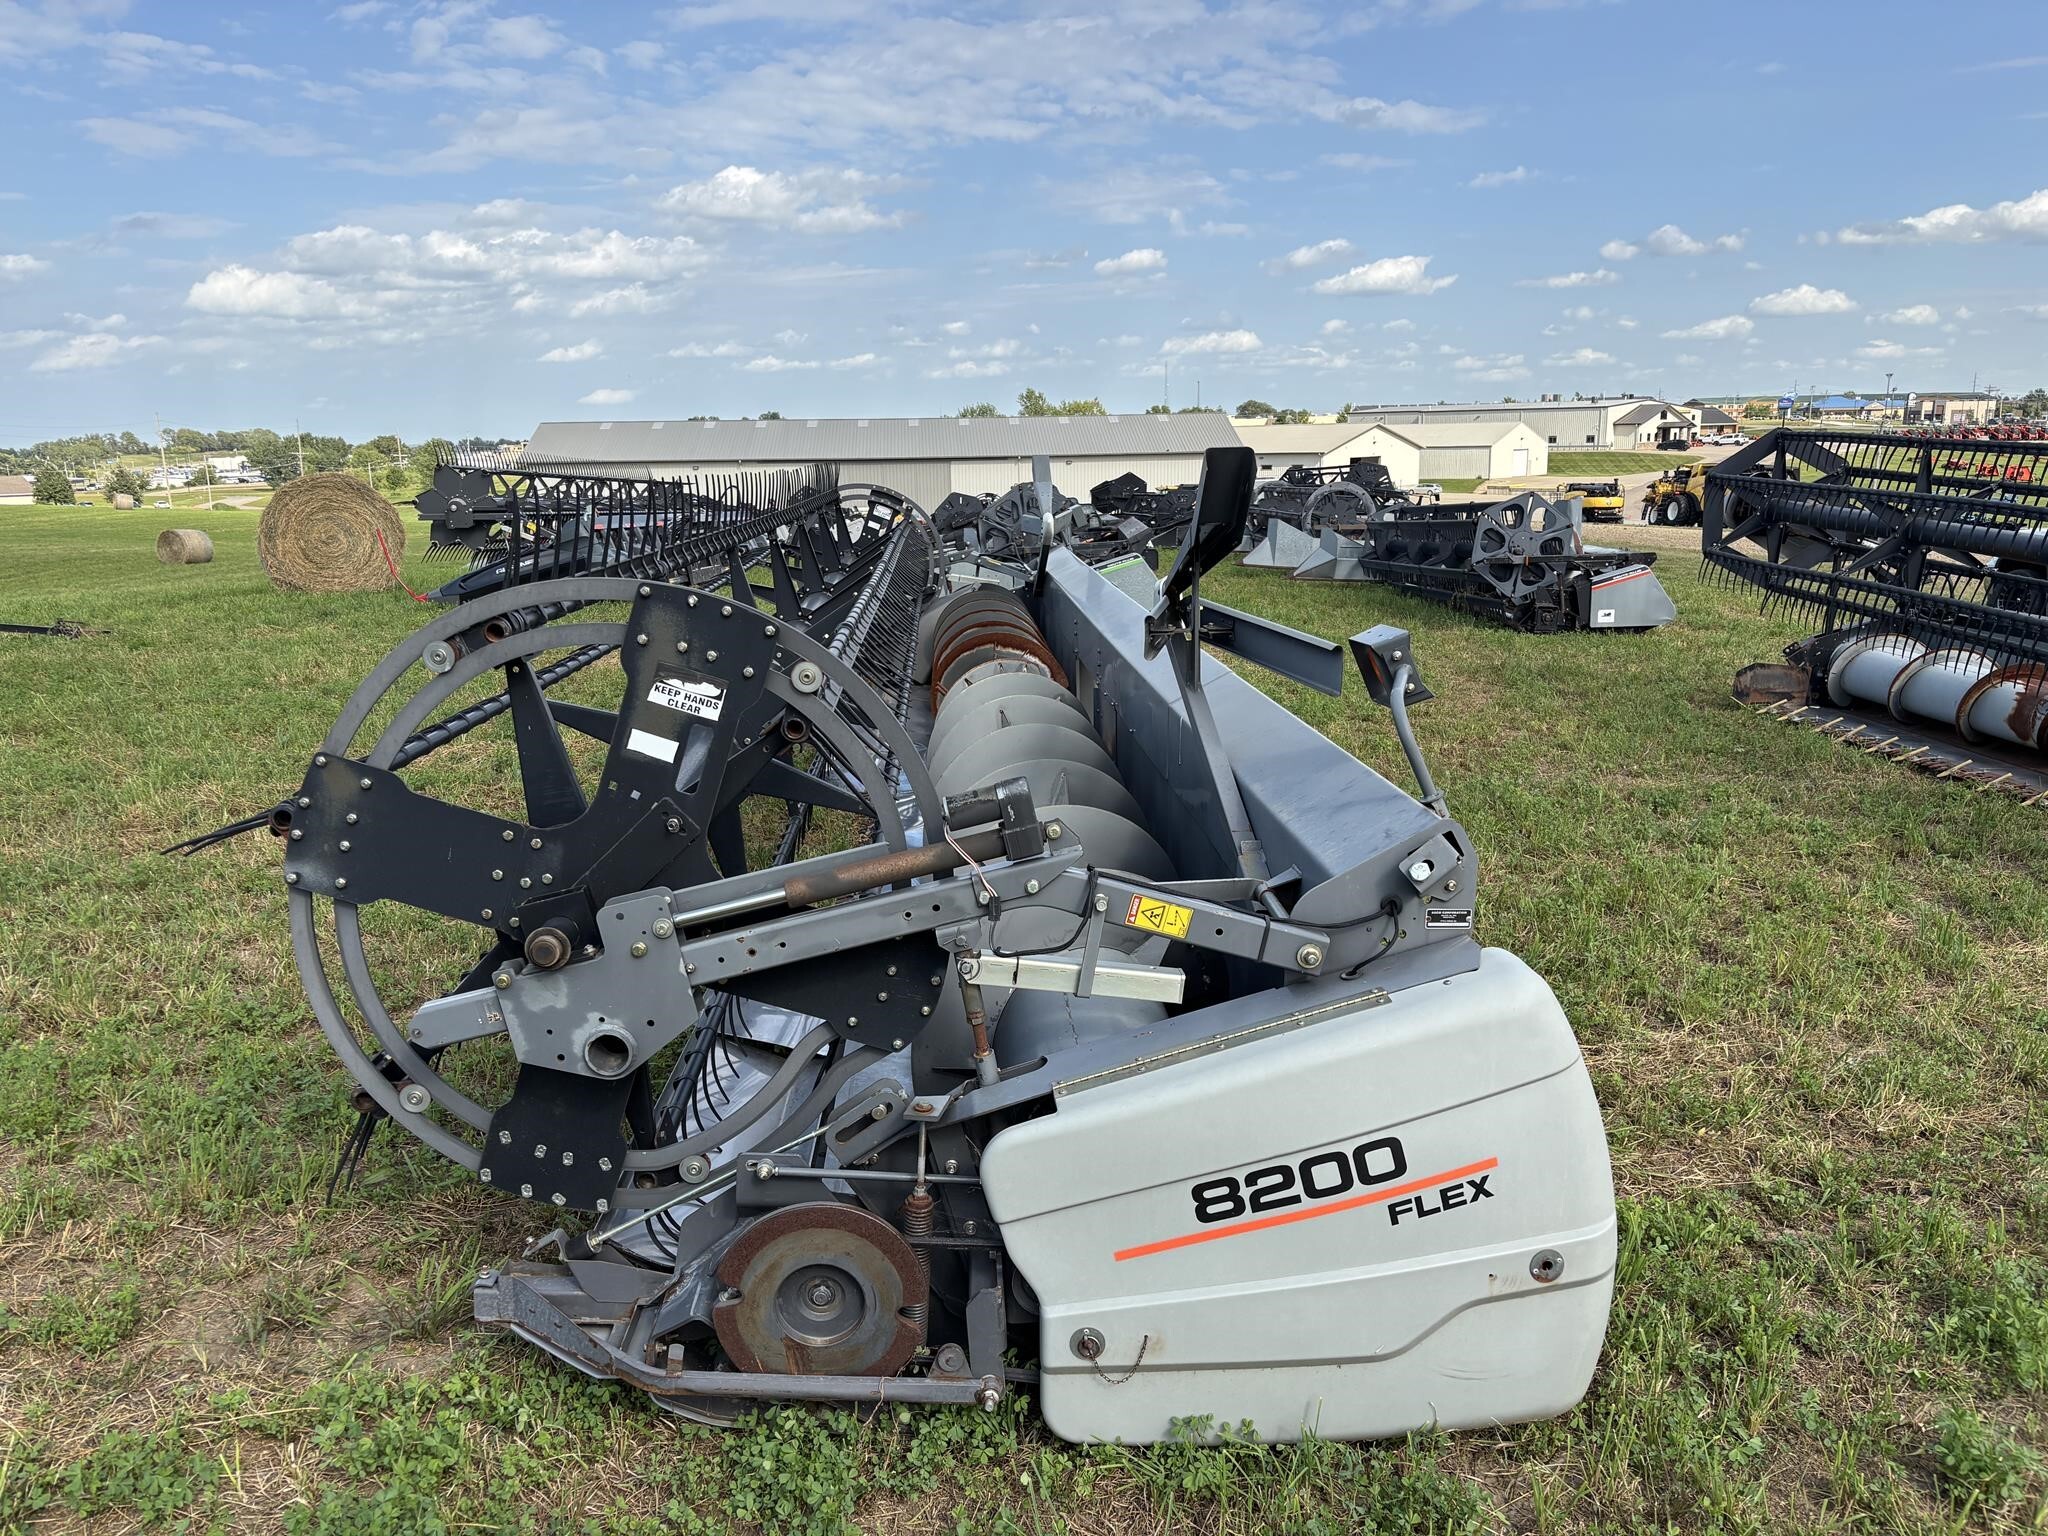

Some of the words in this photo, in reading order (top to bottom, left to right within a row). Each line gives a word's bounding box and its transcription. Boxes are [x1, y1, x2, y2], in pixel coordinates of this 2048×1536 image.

[654, 684, 681, 698] KEEP
[684, 693, 719, 710] HANDS
[667, 698, 701, 714] CLEAR
[1191, 1136, 1407, 1224] 8200
[1387, 1174, 1495, 1227] FLEX
